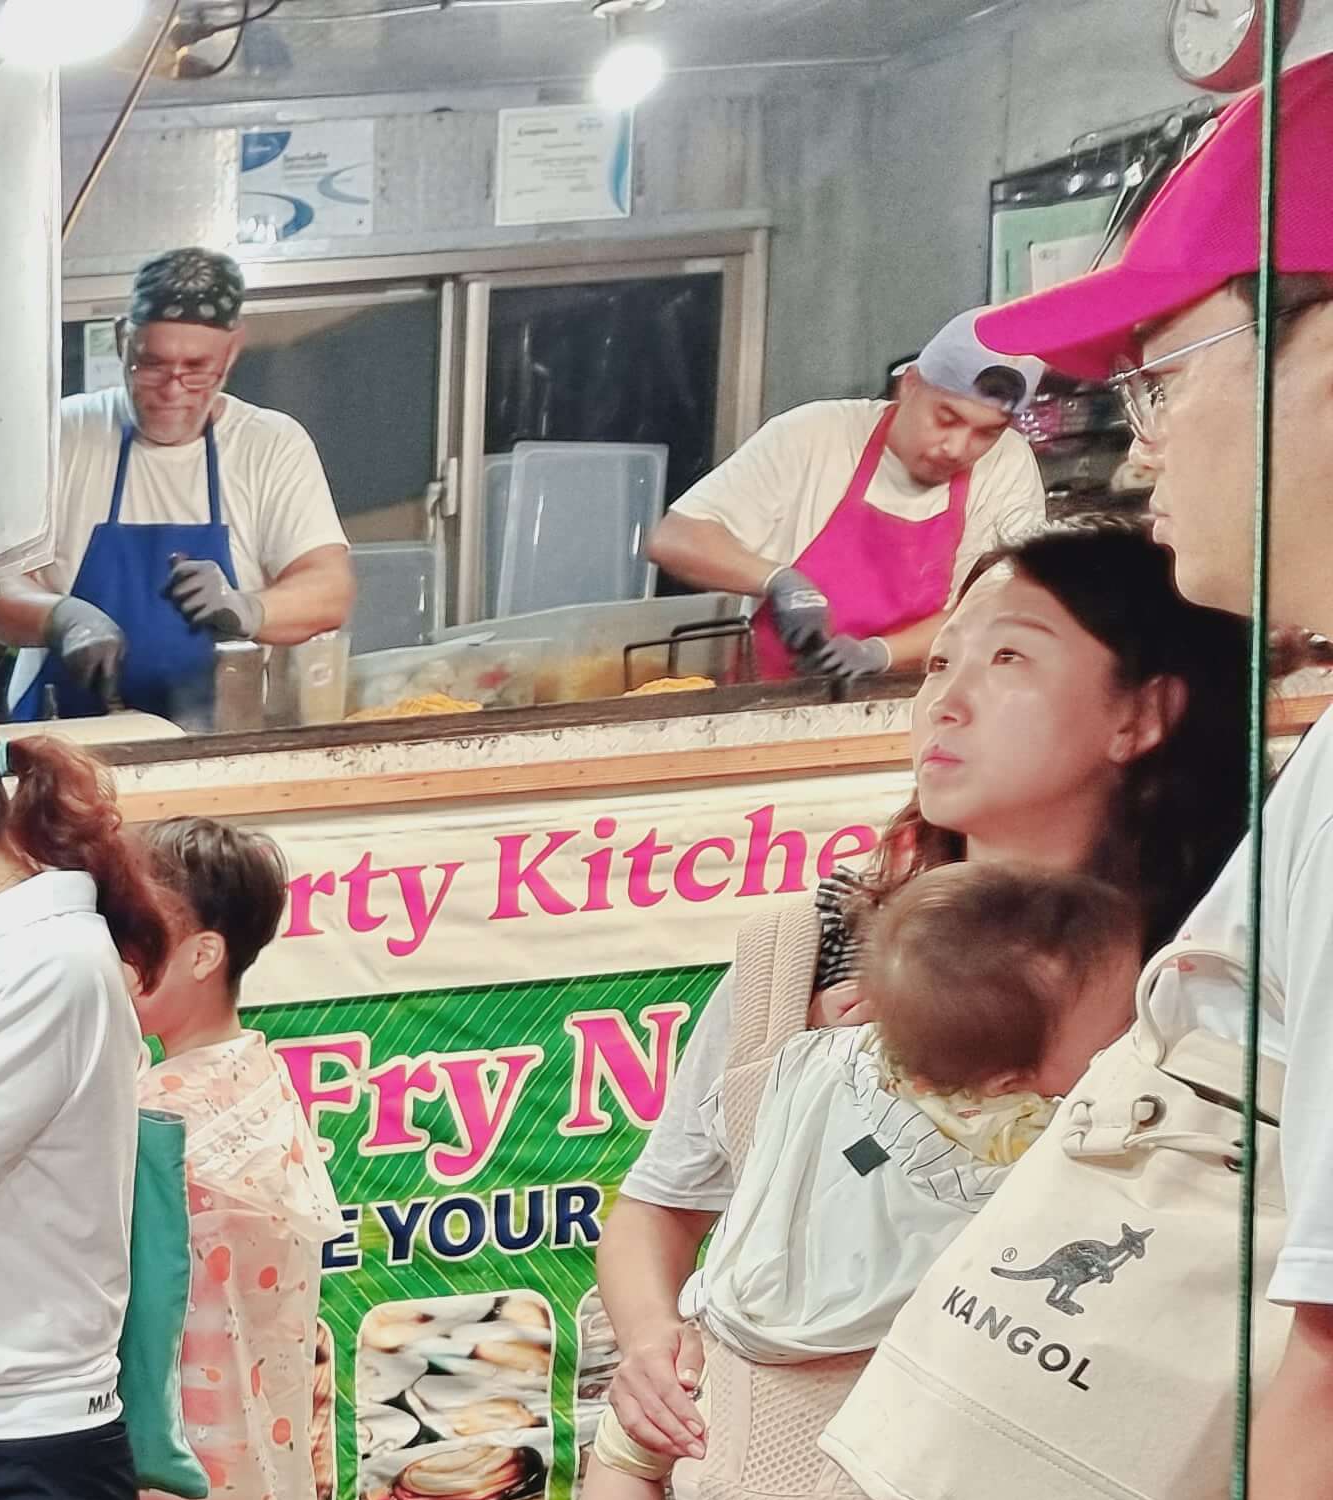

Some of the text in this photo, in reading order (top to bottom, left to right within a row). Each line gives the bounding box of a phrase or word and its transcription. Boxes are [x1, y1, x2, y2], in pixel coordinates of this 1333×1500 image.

[271, 1006, 687, 1182] Fry N
[376, 1185, 602, 1262] YOUR
[941, 1285, 1091, 1392] KANGOL
